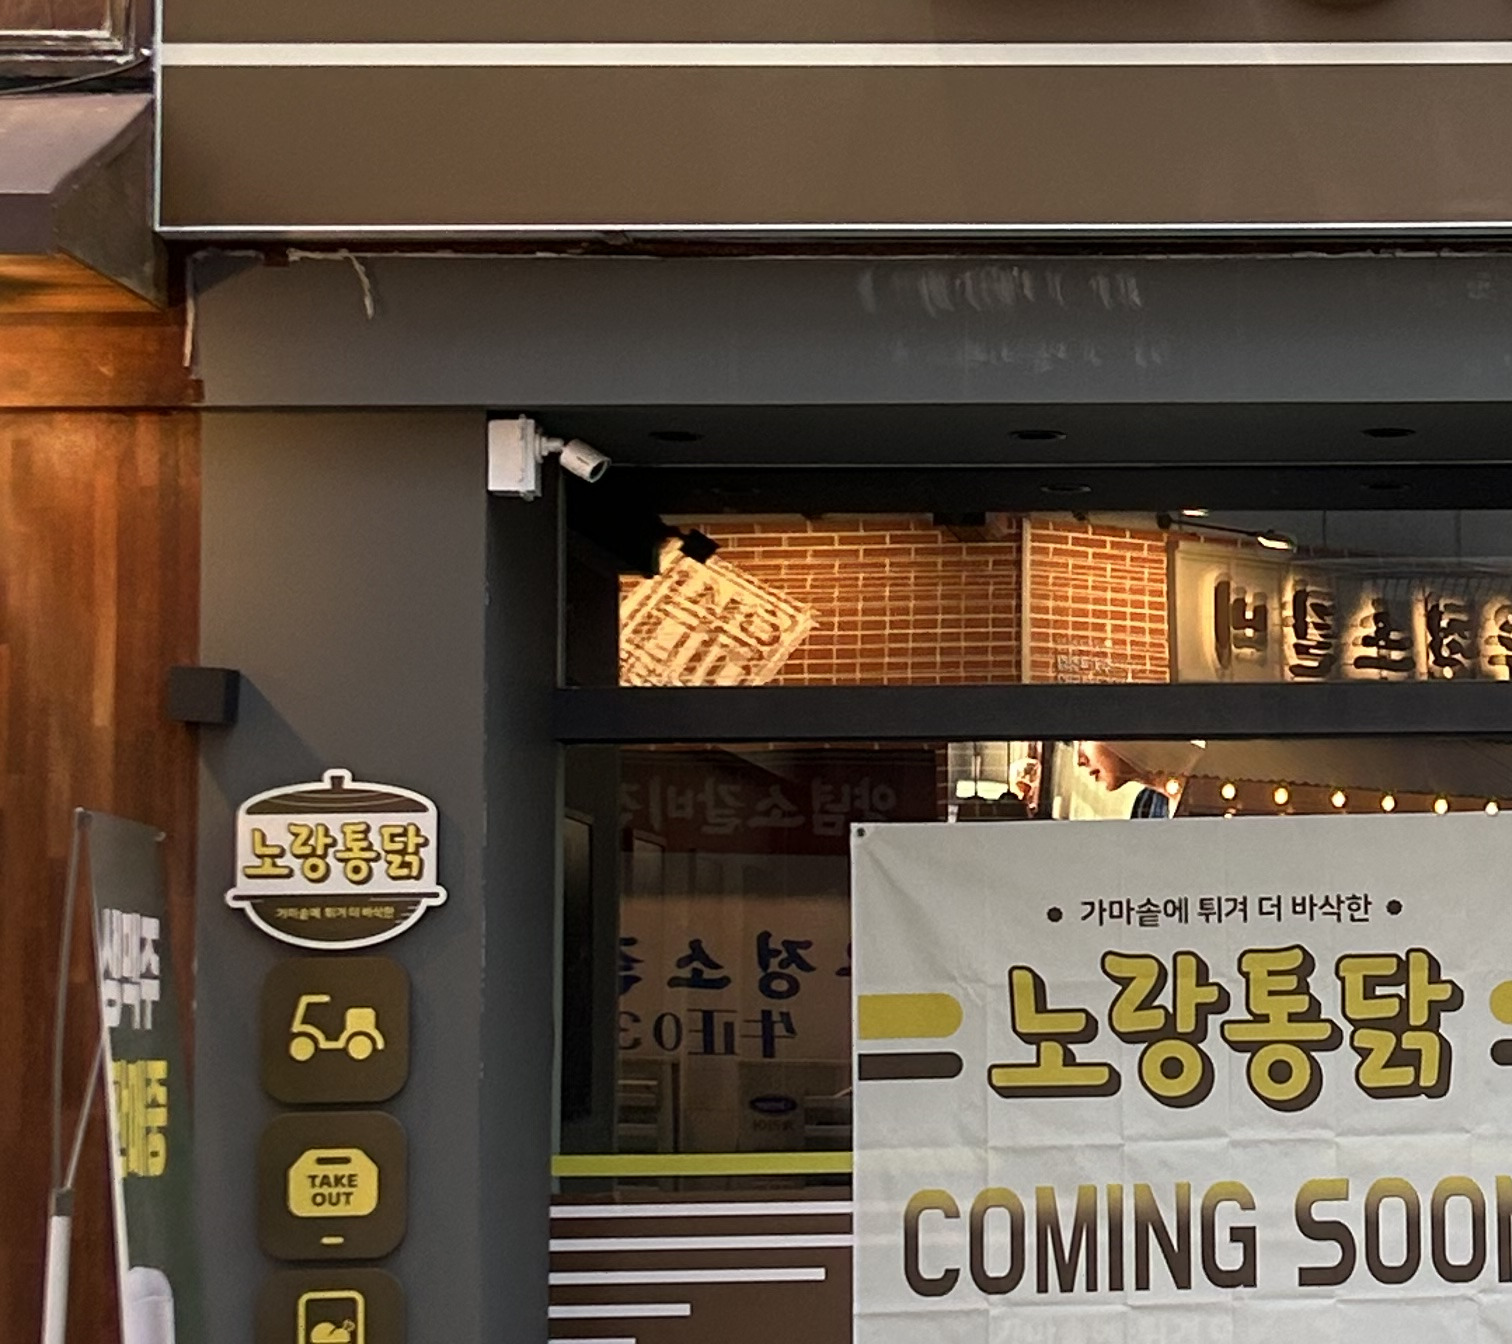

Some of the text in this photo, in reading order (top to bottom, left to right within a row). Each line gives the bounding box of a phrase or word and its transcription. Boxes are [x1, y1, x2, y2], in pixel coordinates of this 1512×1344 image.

[242, 820, 429, 885] 노랑통닭
[1080, 893, 1373, 927] 가마솥에 튀겨 더 바삭한
[988, 944, 1463, 1112] 노랑통닭
[308, 1173, 359, 1189] TAKE
[311, 1191, 354, 1207] OUT
[903, 1180, 1258, 1297] COMING
